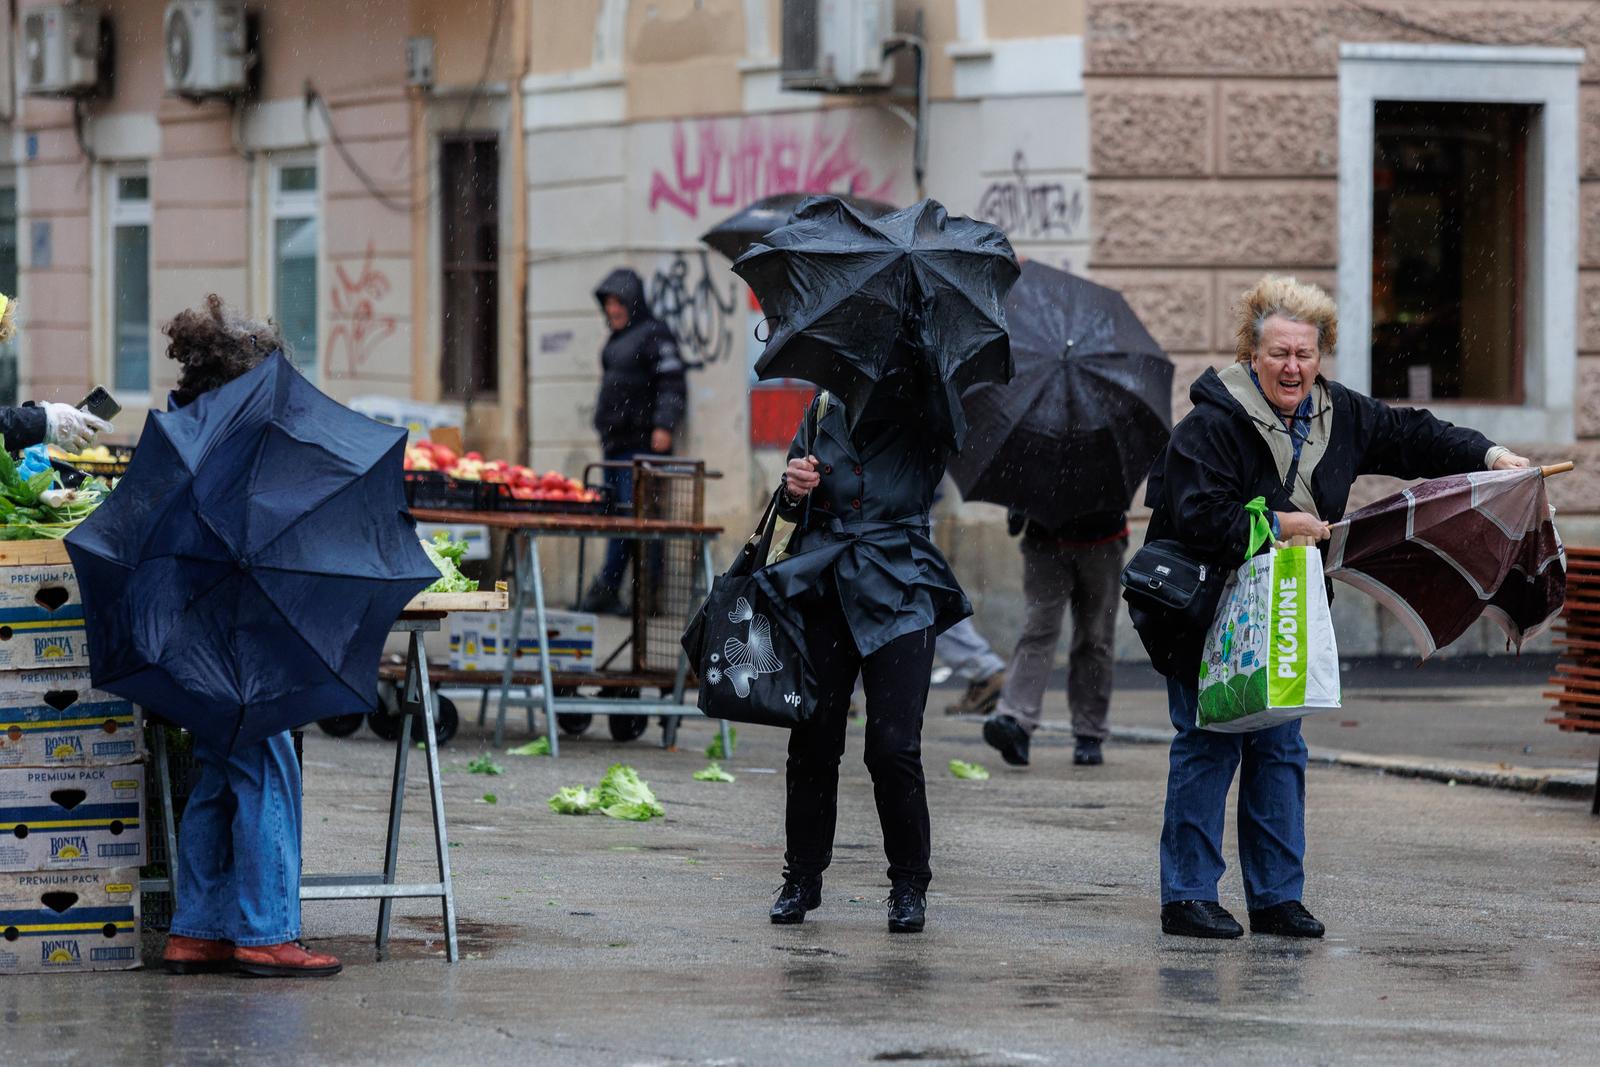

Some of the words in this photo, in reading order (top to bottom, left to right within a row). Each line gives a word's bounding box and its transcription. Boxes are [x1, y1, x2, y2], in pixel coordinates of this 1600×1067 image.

[11, 573, 59, 584] PREMIUM
[63, 572, 77, 582] PA
[1278, 576, 1298, 679] PLODINE
[34, 636, 72, 656] BONITA
[20, 673, 69, 683] PREMIUM
[72, 671, 91, 680] PAC
[783, 692, 802, 707] vip
[45, 735, 82, 755] BONITA
[28, 772, 76, 782] PREMIUM
[80, 771, 106, 780] PACK
[51, 836, 88, 855] BONITA
[19, 875, 69, 885] PREMIUM
[72, 874, 99, 884] PACK
[41, 940, 81, 960] BONITA
